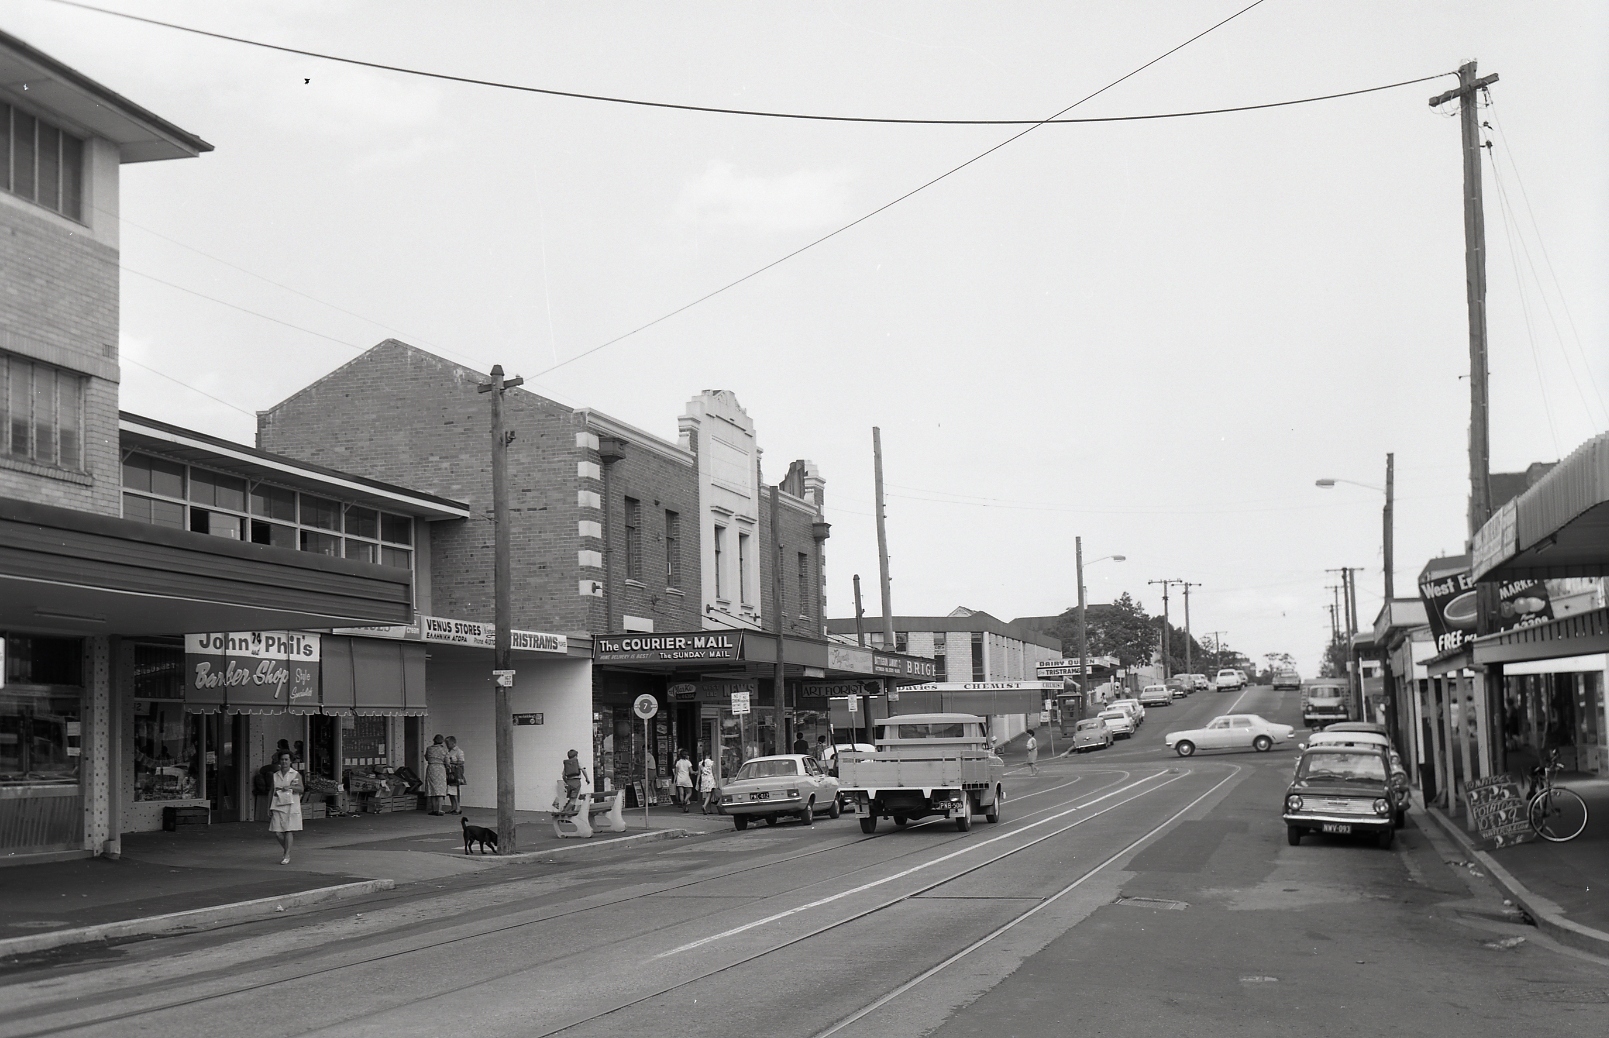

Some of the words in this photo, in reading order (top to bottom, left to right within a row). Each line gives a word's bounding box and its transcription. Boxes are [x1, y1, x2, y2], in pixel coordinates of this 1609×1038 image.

[1421, 578, 1455, 599] West
[1457, 574, 1477, 590] En
[426, 619, 452, 632] VENUS
[455, 622, 481, 636] STORES
[199, 632, 249, 651] John
[265, 635, 313, 656] Phil's
[511, 632, 558, 650] RISTRAMS
[600, 640, 619, 652] The
[622, 636, 733, 650] COURIER-MAIL
[1438, 630, 1462, 651] FREE
[672, 651, 705, 660] SUNDAY
[709, 651, 730, 659] MAIL
[194, 660, 250, 690] Barber
[252, 660, 289, 699] Shop
[295, 667, 311, 685] Style
[723, 683, 755, 698] NEWS
[963, 682, 1022, 690] CHEMIST
[642, 702, 648, 710] 7
[1473, 800, 1521, 819] POTATOES
